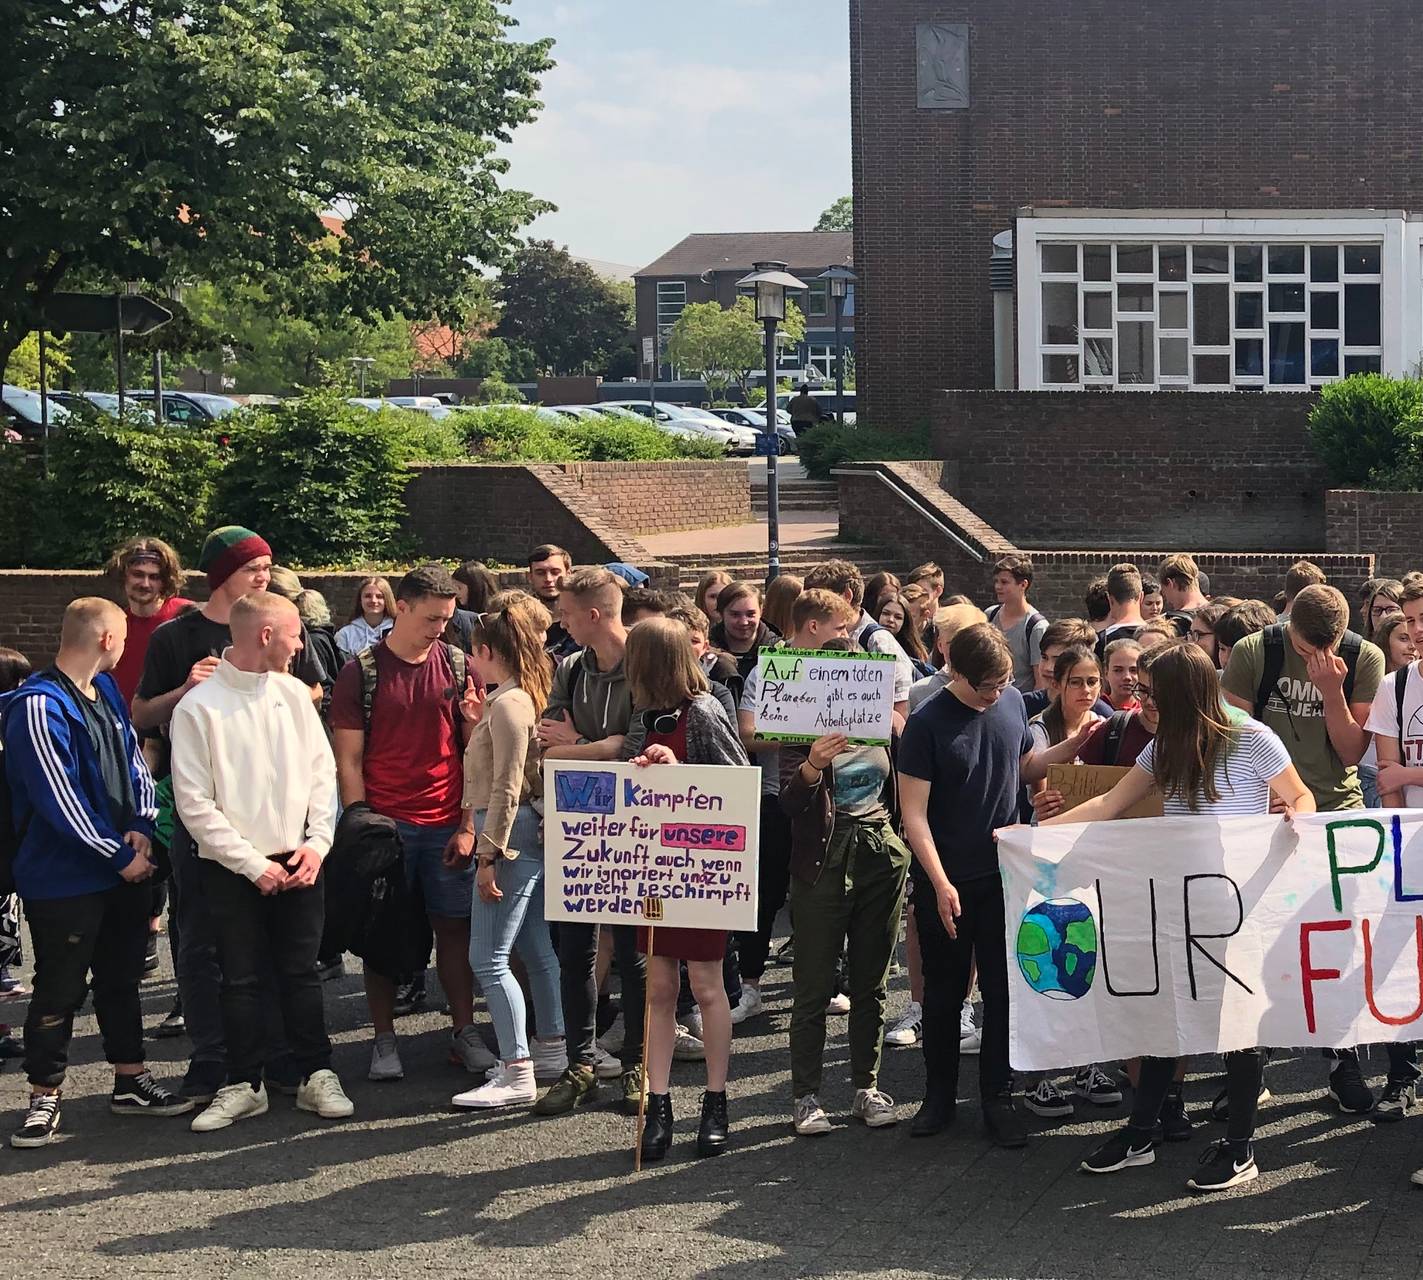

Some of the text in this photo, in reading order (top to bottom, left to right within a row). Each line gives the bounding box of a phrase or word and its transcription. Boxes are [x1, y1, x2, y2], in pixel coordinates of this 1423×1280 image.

[763, 659, 882, 682] Auf einem toten
[827, 684, 843, 708] gibt
[862, 690, 880, 701] auch
[760, 704, 788, 721] keine
[1291, 702, 1325, 717] JEA
[558, 774, 613, 808] Wir
[561, 814, 739, 845] weiter für unsere
[562, 837, 741, 872] Zukunft auch wenn
[563, 864, 593, 878] wir
[597, 865, 673, 886] ignoriert
[564, 877, 751, 905] unrecht beschimpft
